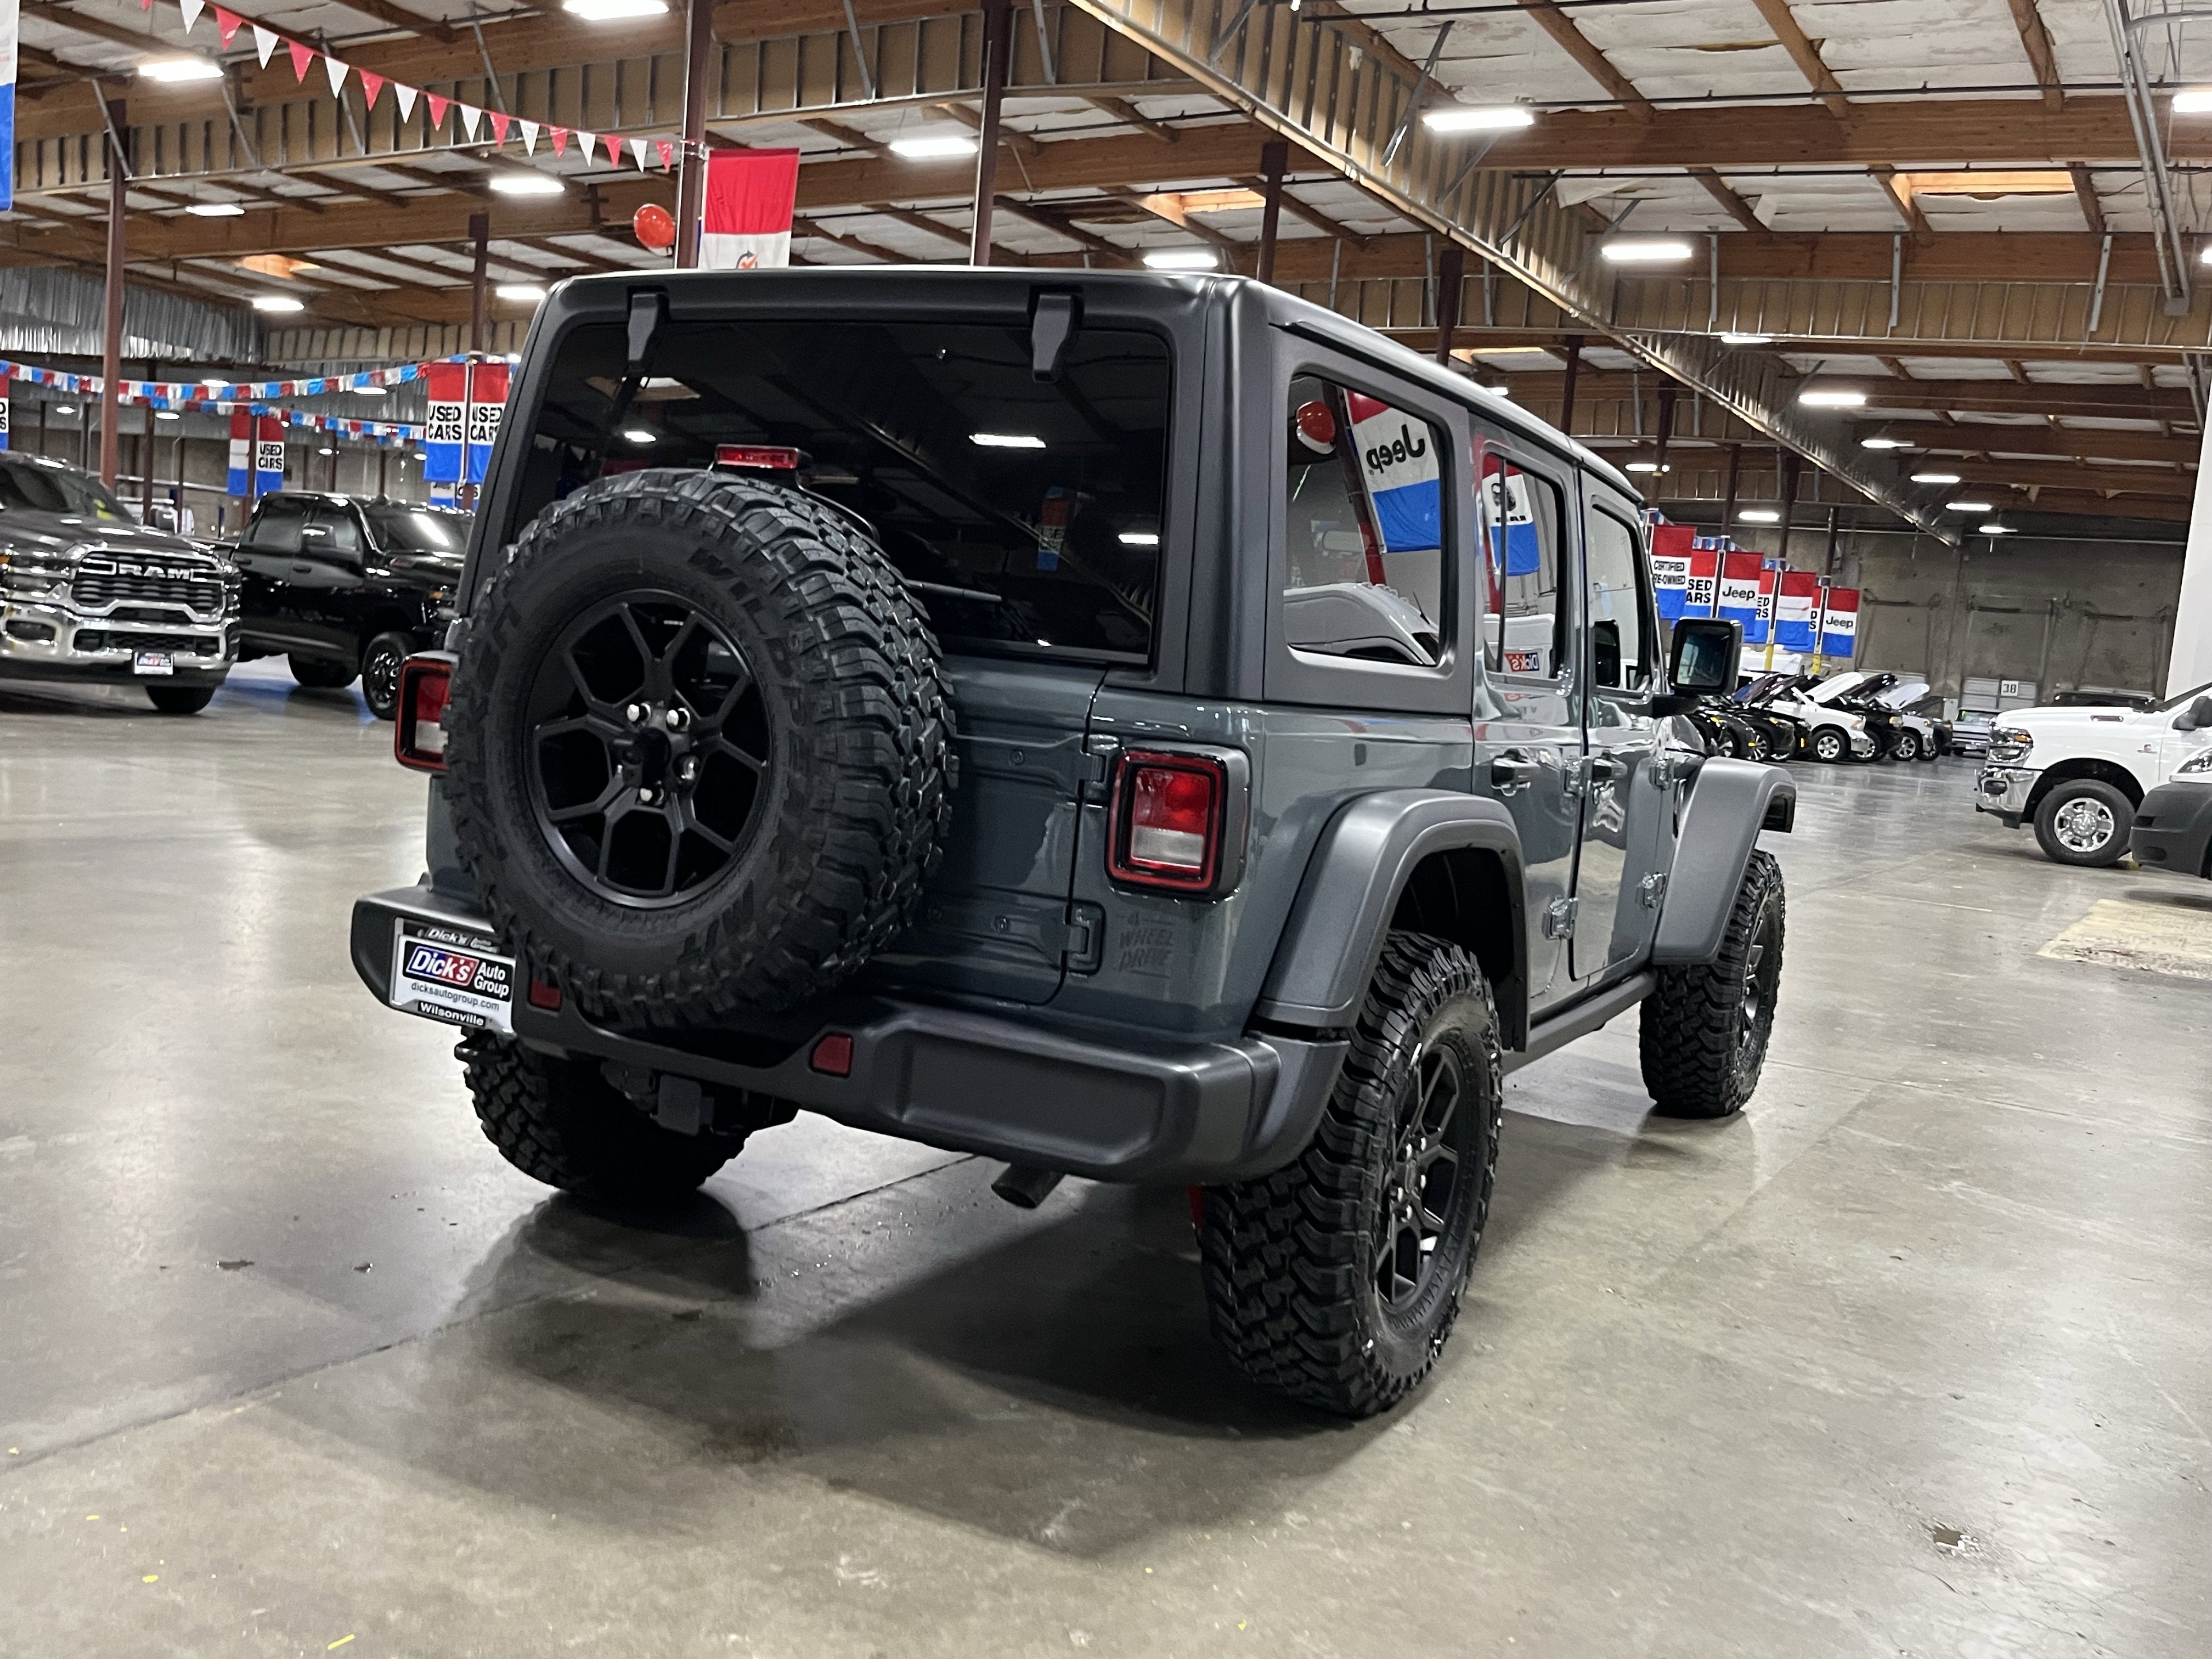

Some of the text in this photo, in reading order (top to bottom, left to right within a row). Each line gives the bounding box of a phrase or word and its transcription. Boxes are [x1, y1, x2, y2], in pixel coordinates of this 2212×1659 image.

[428, 405, 461, 422] USED
[472, 406, 503, 423] USED
[428, 424, 462, 440] CARS
[260, 444, 282, 455] USED
[119, 563, 191, 579] RAM
[1652, 574, 1685, 585] RE-OWNED
[1688, 579, 1712, 591] SED
[1686, 592, 1711, 603] ARS
[1722, 586, 1755, 601] Jeep
[1826, 617, 1853, 629] Jeep
[428, 928, 467, 945] Dick's
[411, 950, 471, 981] Dick's
[477, 962, 506, 981] Auto
[473, 975, 509, 998] Group
[411, 982, 499, 1011] dicksautogroup.com
[420, 1002, 484, 1026] Wilsonville
